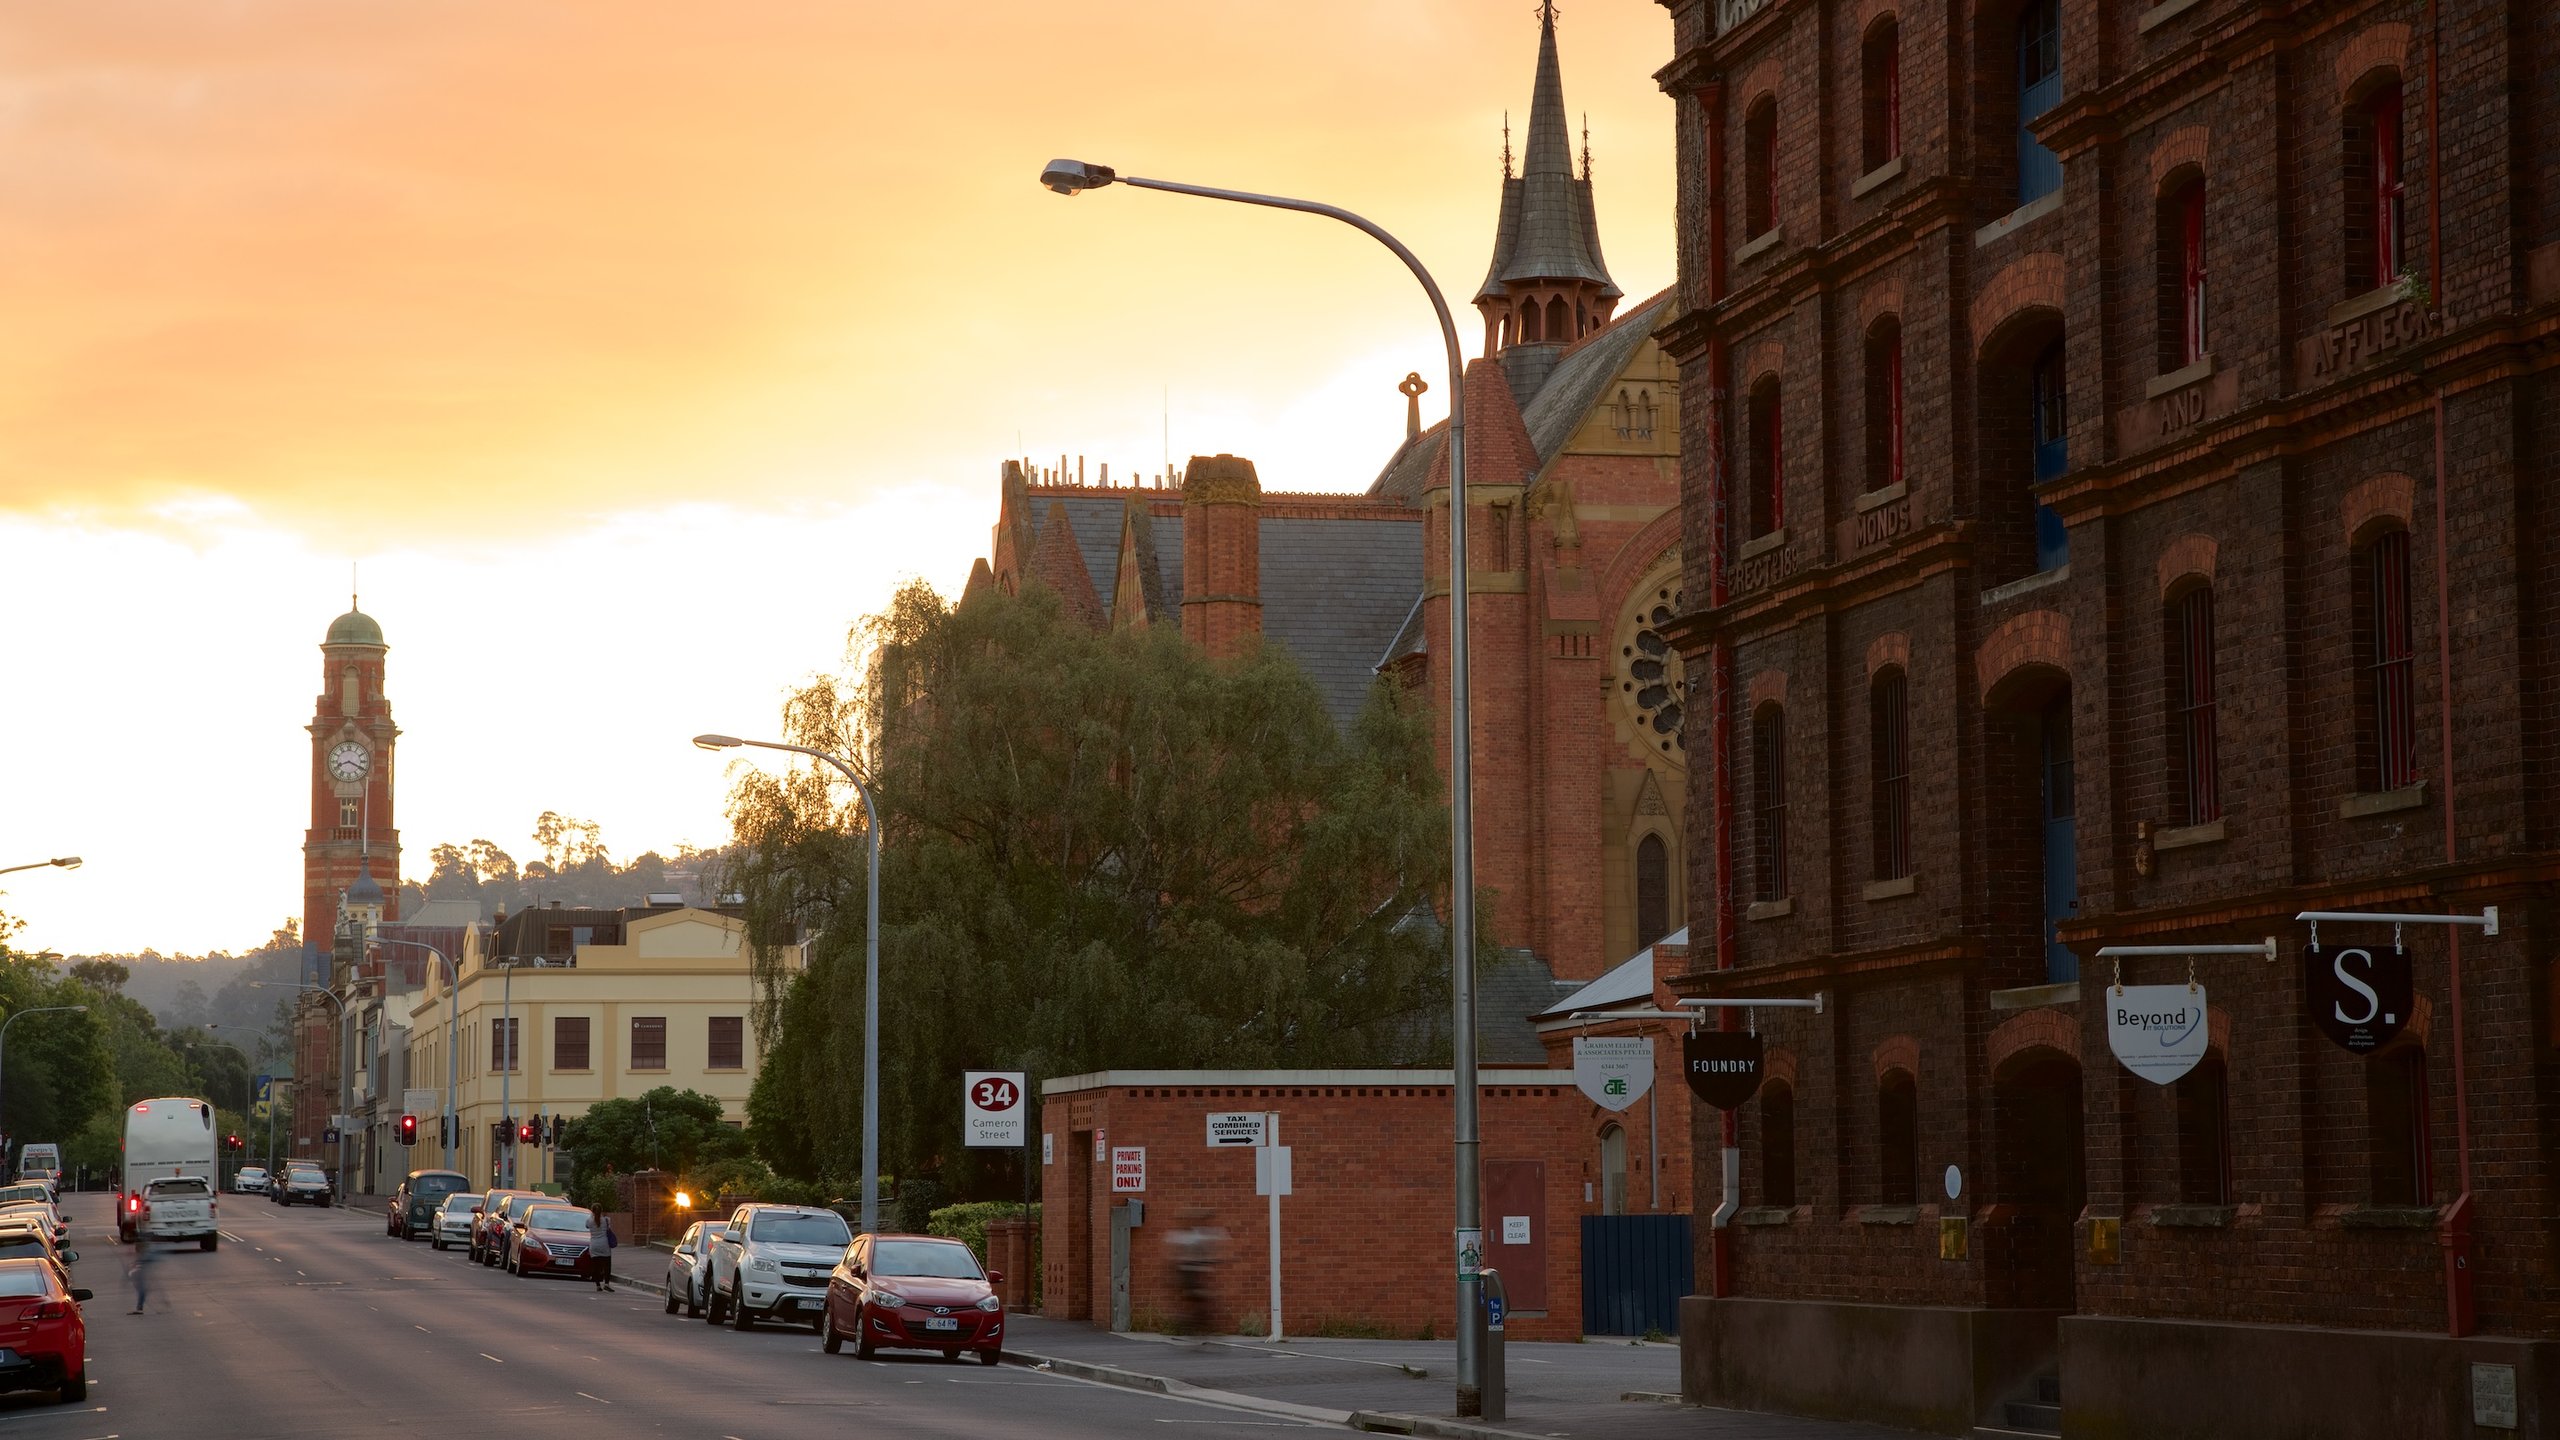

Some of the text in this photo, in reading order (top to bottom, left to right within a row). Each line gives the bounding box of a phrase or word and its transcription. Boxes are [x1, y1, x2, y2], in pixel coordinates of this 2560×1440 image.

[2160, 388, 2205, 435] AND
[1856, 499, 1910, 549] MONDS
[2334, 948, 2396, 1025] S.
[2117, 1007, 2187, 1031] Beyond
[1693, 1060, 1755, 1073] FOUNDRY
[979, 1083, 1012, 1106] 34
[972, 1119, 1018, 1128] Cameron
[979, 1130, 1010, 1139] Street
[1117, 1151, 1141, 1161] PRIVATE
[1116, 1164, 1142, 1174] PARKING
[1117, 1177, 1141, 1188] ONLY
[161, 1209, 201, 1220] TOYOTA
[1507, 1232, 1527, 1240] CLEAR
[1492, 1313, 1501, 1323] P
